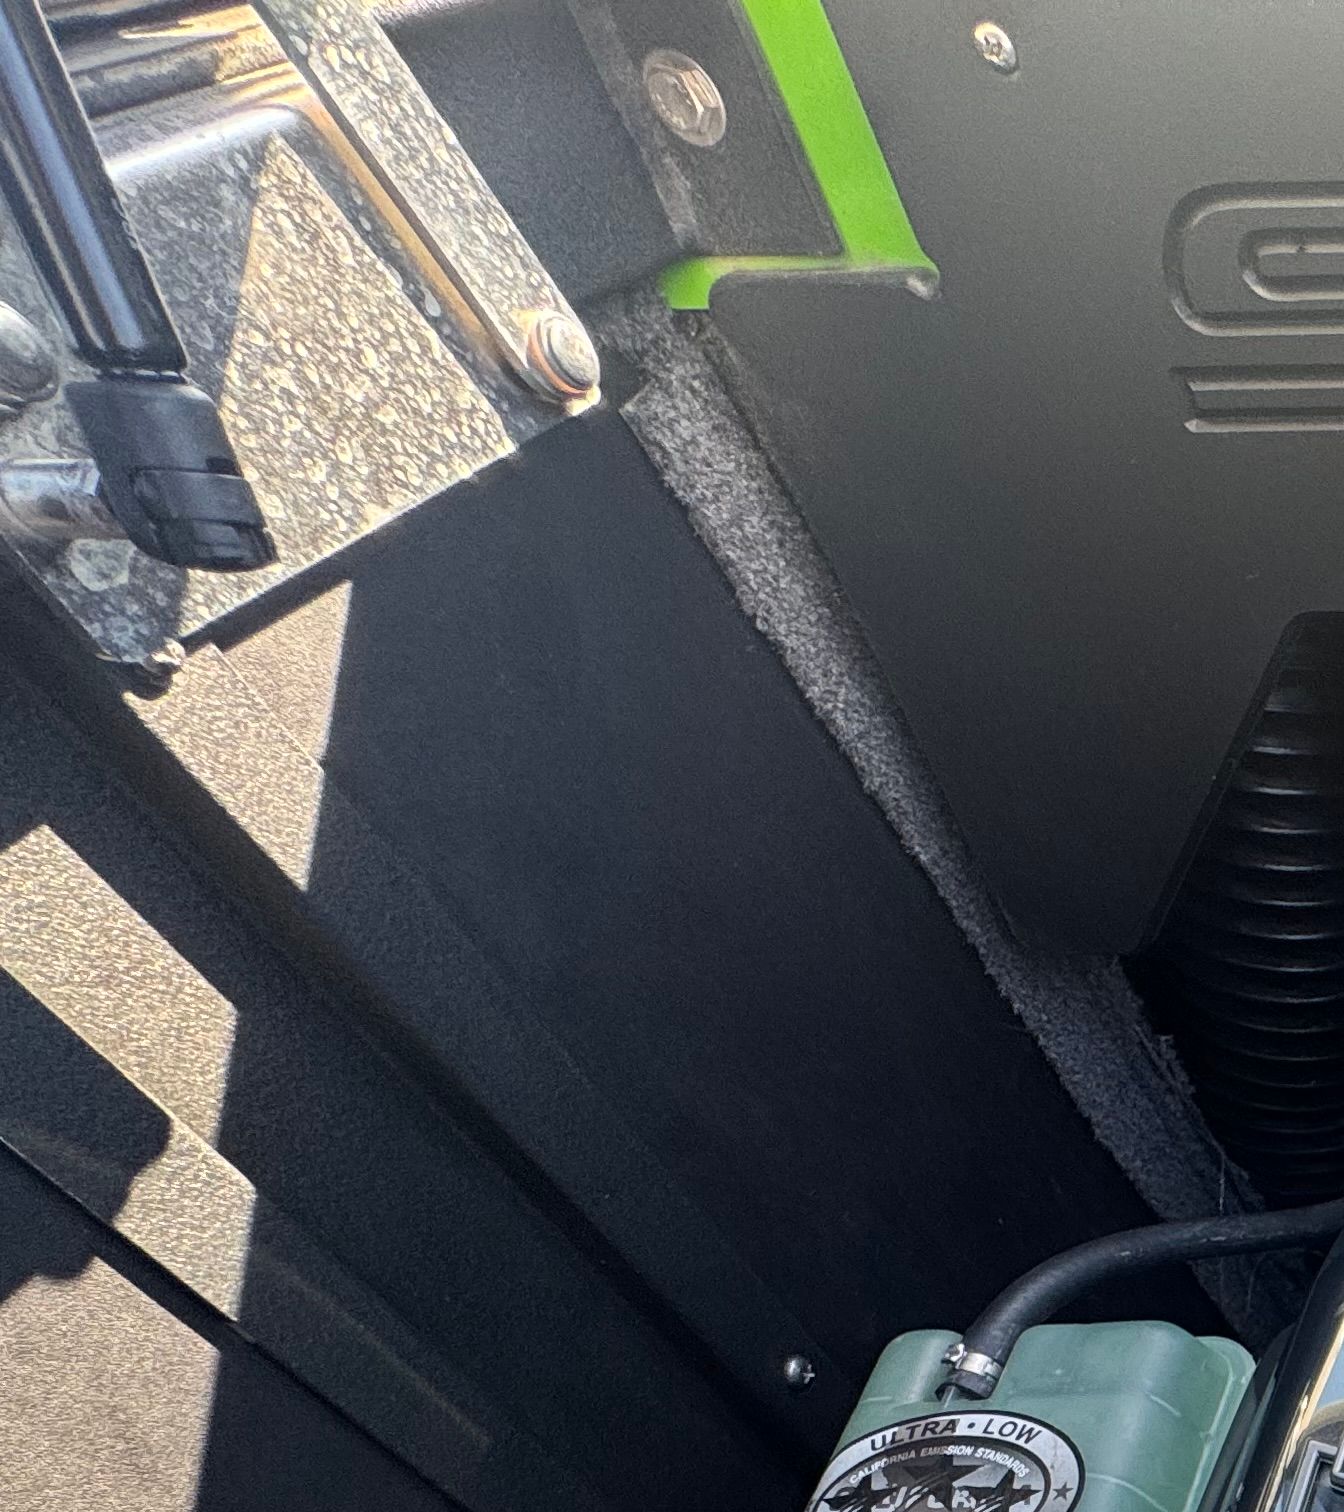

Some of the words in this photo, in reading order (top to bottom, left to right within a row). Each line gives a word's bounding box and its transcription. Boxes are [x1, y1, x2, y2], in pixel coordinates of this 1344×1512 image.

[870, 1419, 958, 1451] ULTRA
[982, 1418, 1042, 1445] LOW
[849, 1450, 917, 1485] CALIFORNIA
[919, 1445, 974, 1457] EMISSION
[975, 1447, 1032, 1478] STANDARDS
